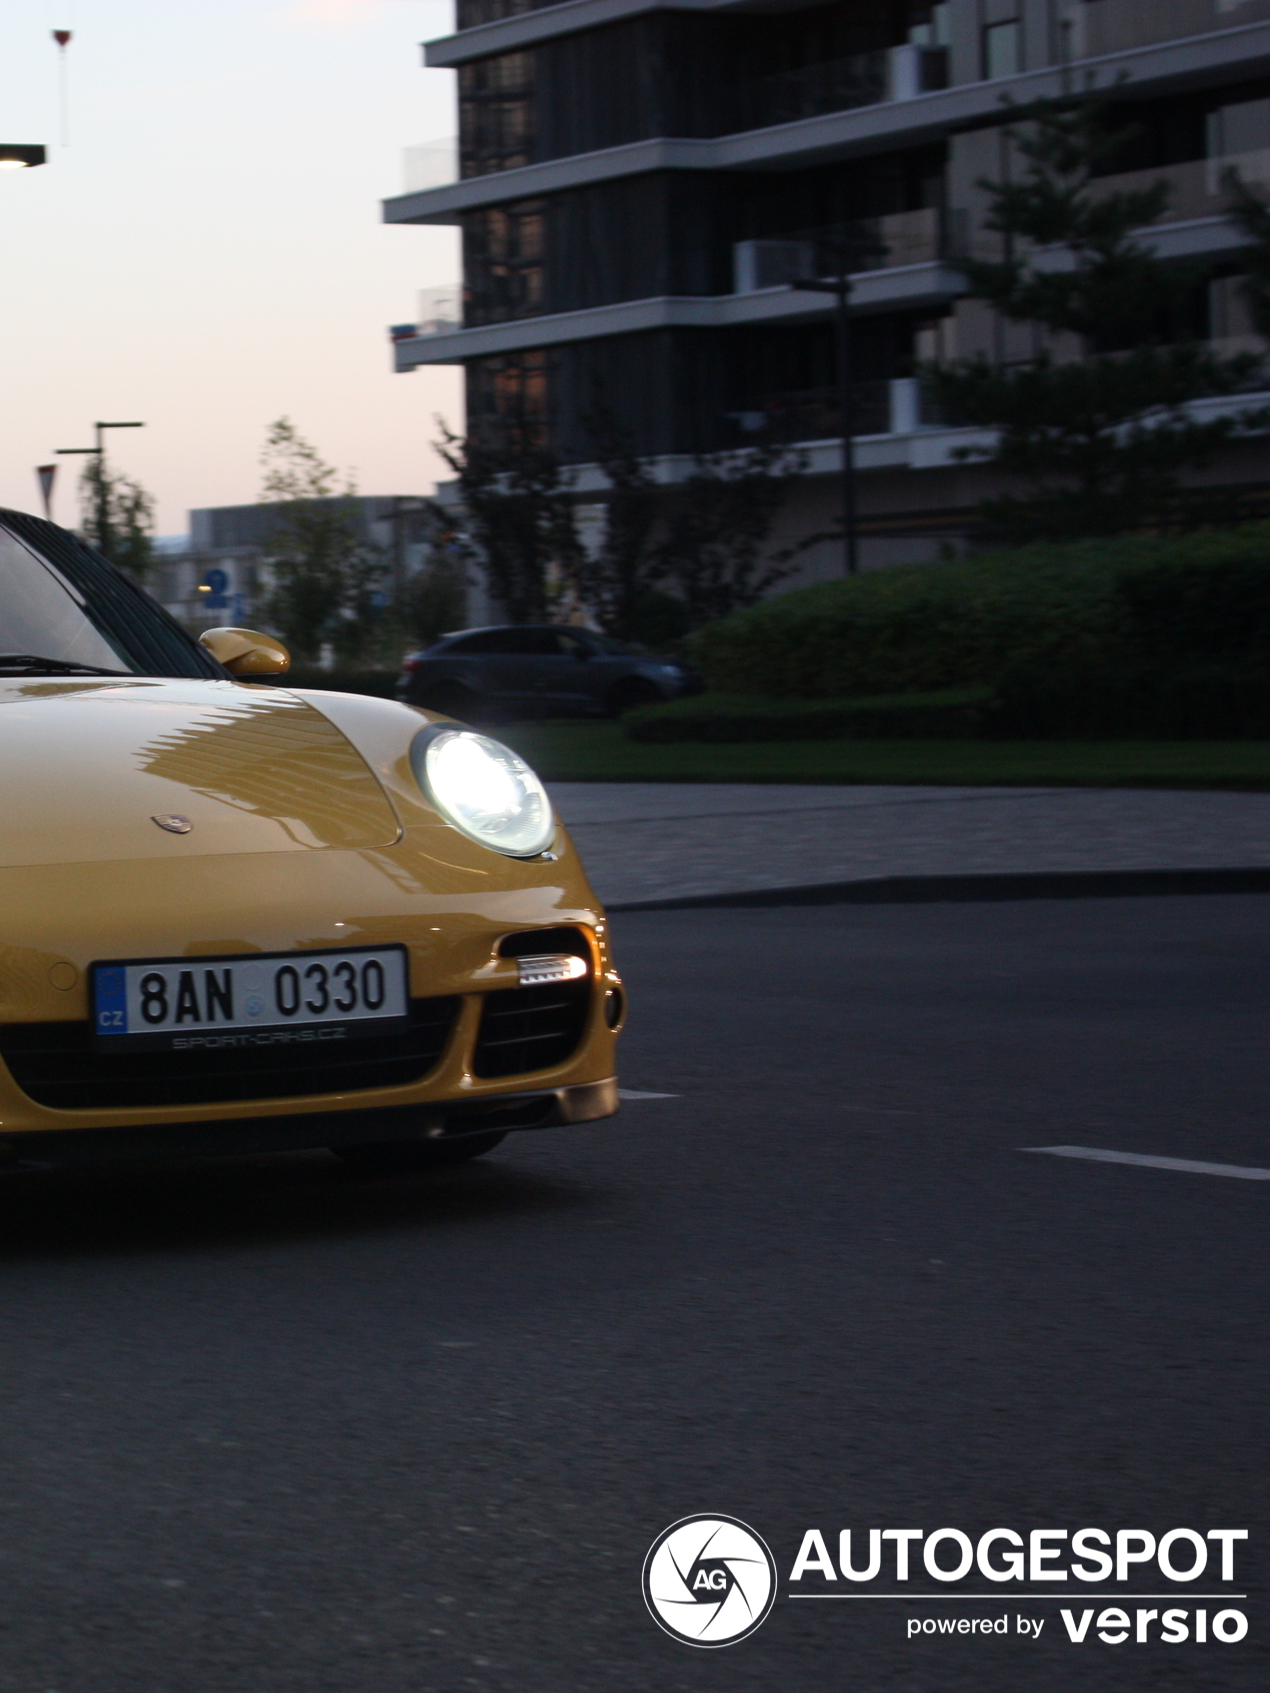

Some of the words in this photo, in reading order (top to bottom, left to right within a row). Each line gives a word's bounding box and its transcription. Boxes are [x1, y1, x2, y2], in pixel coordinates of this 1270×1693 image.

[141, 968, 233, 1024] 8AN
[276, 960, 383, 1016] 0330
[99, 1011, 124, 1026] CZ
